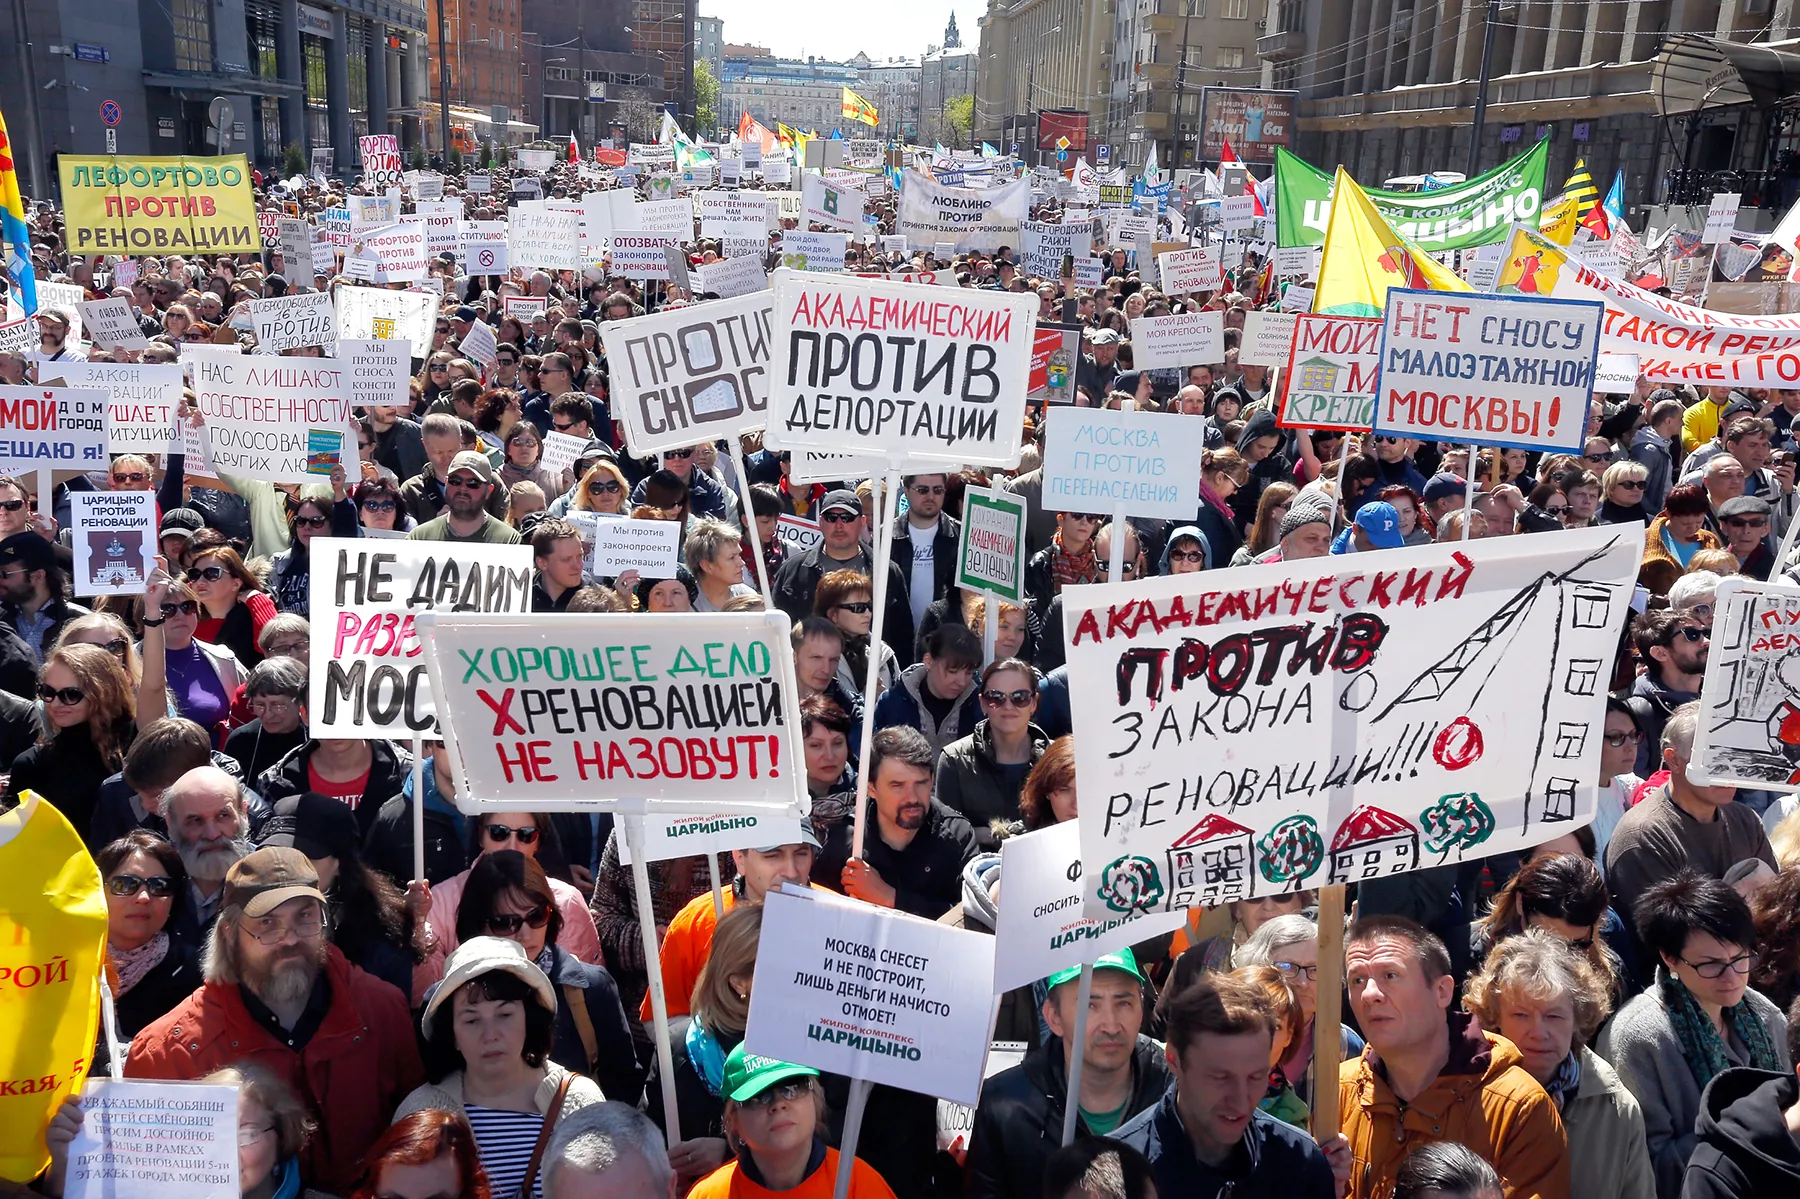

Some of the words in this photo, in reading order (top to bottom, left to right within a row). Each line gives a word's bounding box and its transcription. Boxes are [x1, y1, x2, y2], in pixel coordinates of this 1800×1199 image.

[72, 165, 241, 187] ЛЕФОРТОВО
[1101, 187, 1132, 196] ПРОТИВ
[105, 196, 217, 217] ПРОТИВ
[703, 200, 765, 209] СОБСТВЕННИКИ!
[932, 196, 992, 209] ЛЮБЛИНО
[1227, 203, 1252, 211] ПРОТИВ
[327, 208, 351, 220] НАМ
[938, 211, 983, 222] ПРОТИВ
[1303, 187, 1540, 243] ЦИЦЫНО
[326, 221, 351, 232] СНОСУ
[902, 221, 938, 232] ПРИНЯТИЯ
[1020, 222, 1092, 236] НИЖЕГОРОДСКИЙ
[78, 226, 252, 249] РЕНОВАЦИИ
[327, 233, 351, 245] НЕТ!
[366, 234, 423, 247] ЛЕФОРТОВО
[786, 235, 802, 243] МОЙ
[1041, 236, 1071, 246] РАЙОН
[379, 248, 415, 259] ПРОТИВ
[822, 255, 844, 263] РАЙОН
[1169, 250, 1207, 262] ПРОТИВ
[623, 262, 669, 272] реноваци
[1173, 275, 1222, 290] РЕНОВАЦИИ
[791, 291, 1012, 343] АКАДЕМИЧЕСКИЙ
[1155, 317, 1176, 327] МОЙ
[1177, 316, 1198, 326] ДОМ
[1394, 301, 1470, 343] НЕТ
[1480, 316, 1585, 349] СНОСУ
[262, 316, 331, 339] ПРОТИВ
[1147, 330, 1166, 339] МОЯ
[1168, 326, 1212, 337] КРЕПОСТЬ
[1605, 308, 1718, 353] ТАКОЙ
[271, 331, 338, 351] РЕНОВАЦИИ
[365, 344, 385, 354] МЫ
[352, 356, 398, 366] ПРОТИВ
[787, 331, 1001, 403] ПРОТИВ
[1386, 348, 1592, 388] МАЛОЭТАЖНОЙ
[86, 368, 140, 382] ЗАКОН
[201, 362, 234, 385] НАС
[246, 367, 342, 390] ЛИШАЮТ
[354, 367, 394, 378] СНОСА
[352, 380, 396, 390] КОНСТИ
[353, 391, 394, 402] ТУЦИИ!
[638, 367, 768, 435] СНОС
[0, 391, 57, 431] МОЙ
[201, 392, 351, 424] СОБСТВЕННОСТИ
[1386, 389, 1561, 438] МОСКВЫ!
[59, 418, 103, 432] ГОРОД
[786, 394, 998, 446] ДЕПОРТАЦИИ
[1073, 425, 1160, 447] МОСКВА
[0, 440, 75, 460] ЕШАЮ
[212, 450, 271, 473] ДРУГИХ
[1073, 452, 1166, 476] ПРОТИВ
[1051, 477, 1179, 503] ПЕРЕНАСЕЛЕНИЯ
[82, 495, 145, 506] ЦАРИЦЫНО
[92, 506, 136, 517] ПРОТИВ
[81, 516, 148, 528] РЕНОВАЦИИ
[1384, 520, 1393, 531] P
[612, 526, 629, 535] Мы
[632, 527, 664, 537] против
[777, 525, 820, 546] НОСУ
[603, 541, 672, 553] законопроекта
[968, 527, 1016, 557] АКАДЕМИЧЕСКИЙ
[615, 558, 665, 567] реновации
[335, 549, 397, 606] НЕ
[406, 556, 531, 613] ДАДИМ
[1071, 551, 1475, 647] АКАДЕМИЧЕСКИЙ
[457, 644, 658, 684] ХОРОШЕЕ
[666, 641, 771, 680] ДЕЛО
[1116, 612, 1390, 711] ПРОТИВ
[323, 659, 438, 733] МОС
[476, 677, 784, 736] ХРЕНОВАЦИЕЙ
[1107, 681, 1312, 760] ЗАКОНА
[1340, 671, 1378, 714] О
[495, 740, 558, 784] НЕ
[573, 735, 780, 781] НАЗОВУТ!
[1104, 720, 1438, 837] РЕНОВАЦИИ!!!
[666, 816, 758, 838] ЦАРИЦЫНО
[1033, 894, 1080, 918] СНОСИТЬ
[825, 937, 876, 962] МОСКВА
[880, 949, 929, 971] СНЕСЕТ
[823, 958, 833, 971] И
[836, 960, 854, 975] НЕ
[856, 965, 927, 994] ПОСТРОИТ,
[794, 972, 834, 992] ЛИШЬ
[836, 981, 886, 1003] ДЕНЬГИ
[889, 991, 950, 1017] НАЧИСТО
[842, 1002, 896, 1026] ОТМОЕТ!
[808, 1024, 922, 1062] ЦАРИЦЫНО
[84, 1096, 165, 1110] УВАЖАЕМЫЙ
[168, 1100, 225, 1112] СОБЯНИН
[93, 1112, 136, 1124] СЕРГЕЙ
[95, 1126, 141, 1138] ПРОСИМ
[144, 1128, 215, 1143] ДОСТОЙНОЕ
[105, 1140, 142, 1153] ЖИЛЬЕ
[146, 1143, 153, 1153] В
[156, 1143, 204, 1156] РАМКАХ
[77, 1155, 132, 1167] ПРОЕКТА
[135, 1157, 206, 1170] РЕНОВАЦИИ
[76, 1168, 128, 1180] ЭТАЖЕК
[131, 1170, 175, 1183] ГОРОДА
[178, 1173, 230, 1185] МОСКВЫ
